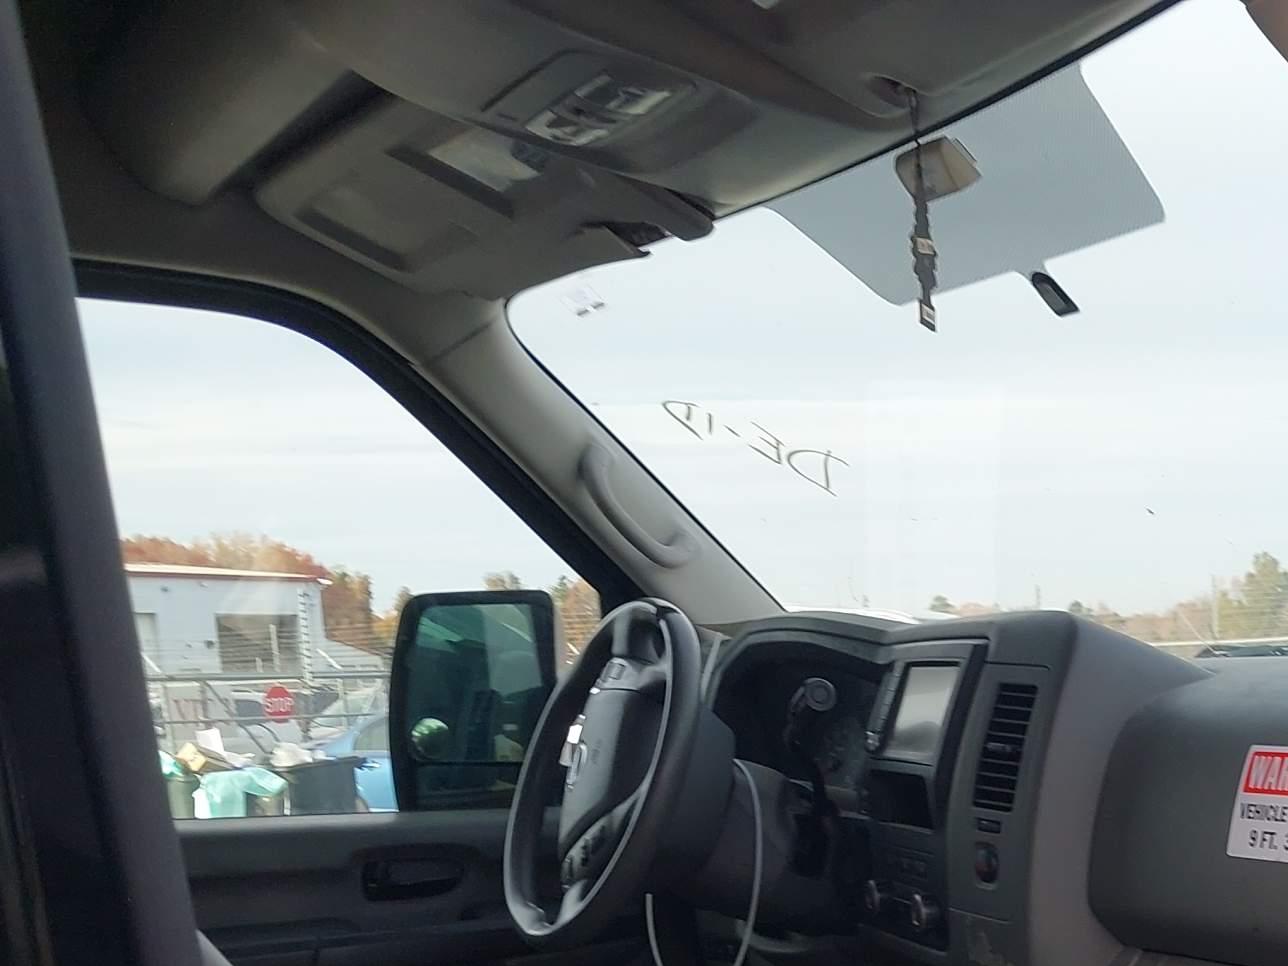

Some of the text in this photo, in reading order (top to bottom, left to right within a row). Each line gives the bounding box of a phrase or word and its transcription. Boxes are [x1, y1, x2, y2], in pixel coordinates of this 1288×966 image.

[264, 697, 294, 713] STOP
[1240, 803, 1288, 822] VEHICLE
[1249, 829, 1258, 848] 9
[1259, 831, 1278, 850] FT.
